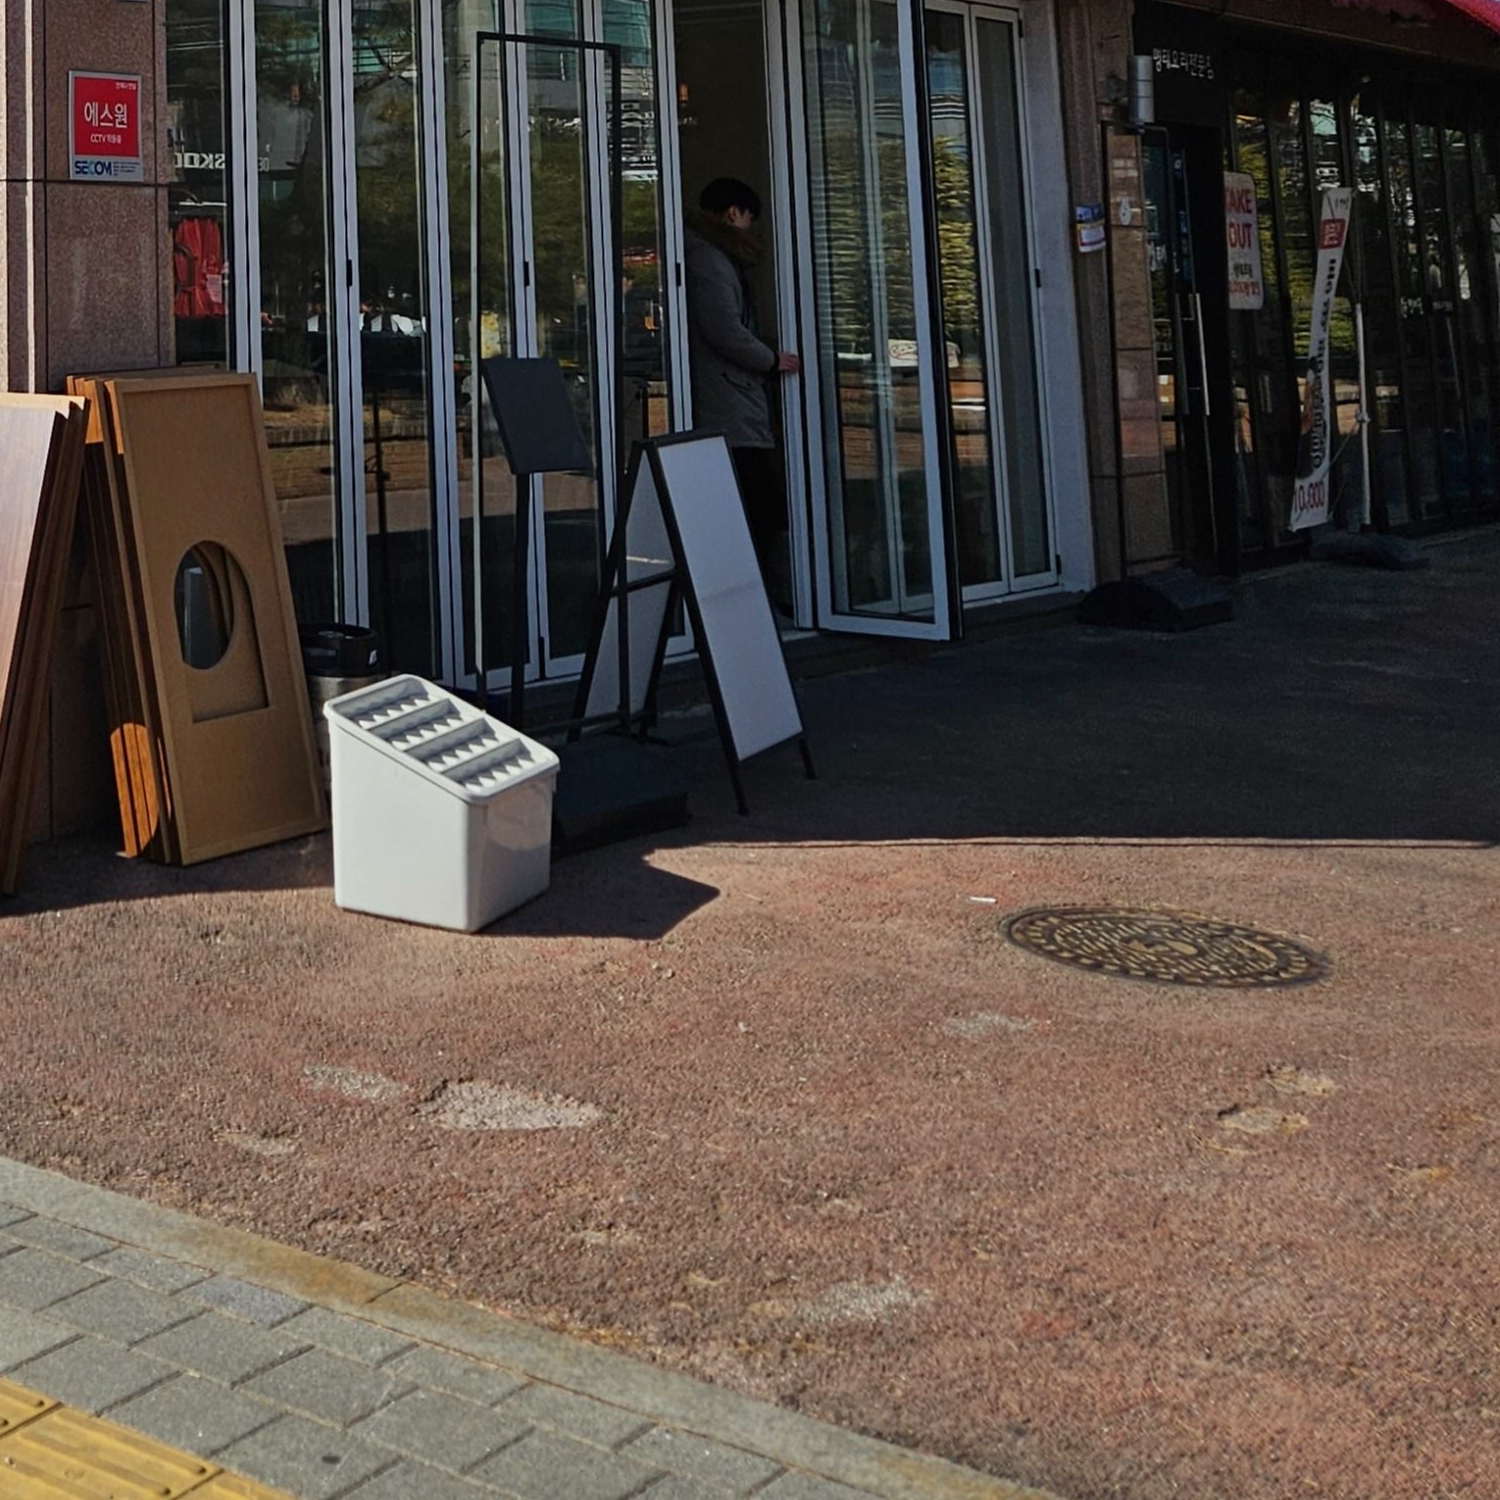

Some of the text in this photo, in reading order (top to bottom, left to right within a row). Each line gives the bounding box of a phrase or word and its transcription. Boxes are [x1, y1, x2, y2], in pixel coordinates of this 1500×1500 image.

[83, 102, 128, 128] 에스원
[74, 160, 112, 176] SECOM
[1228, 221, 1253, 249] OUT
